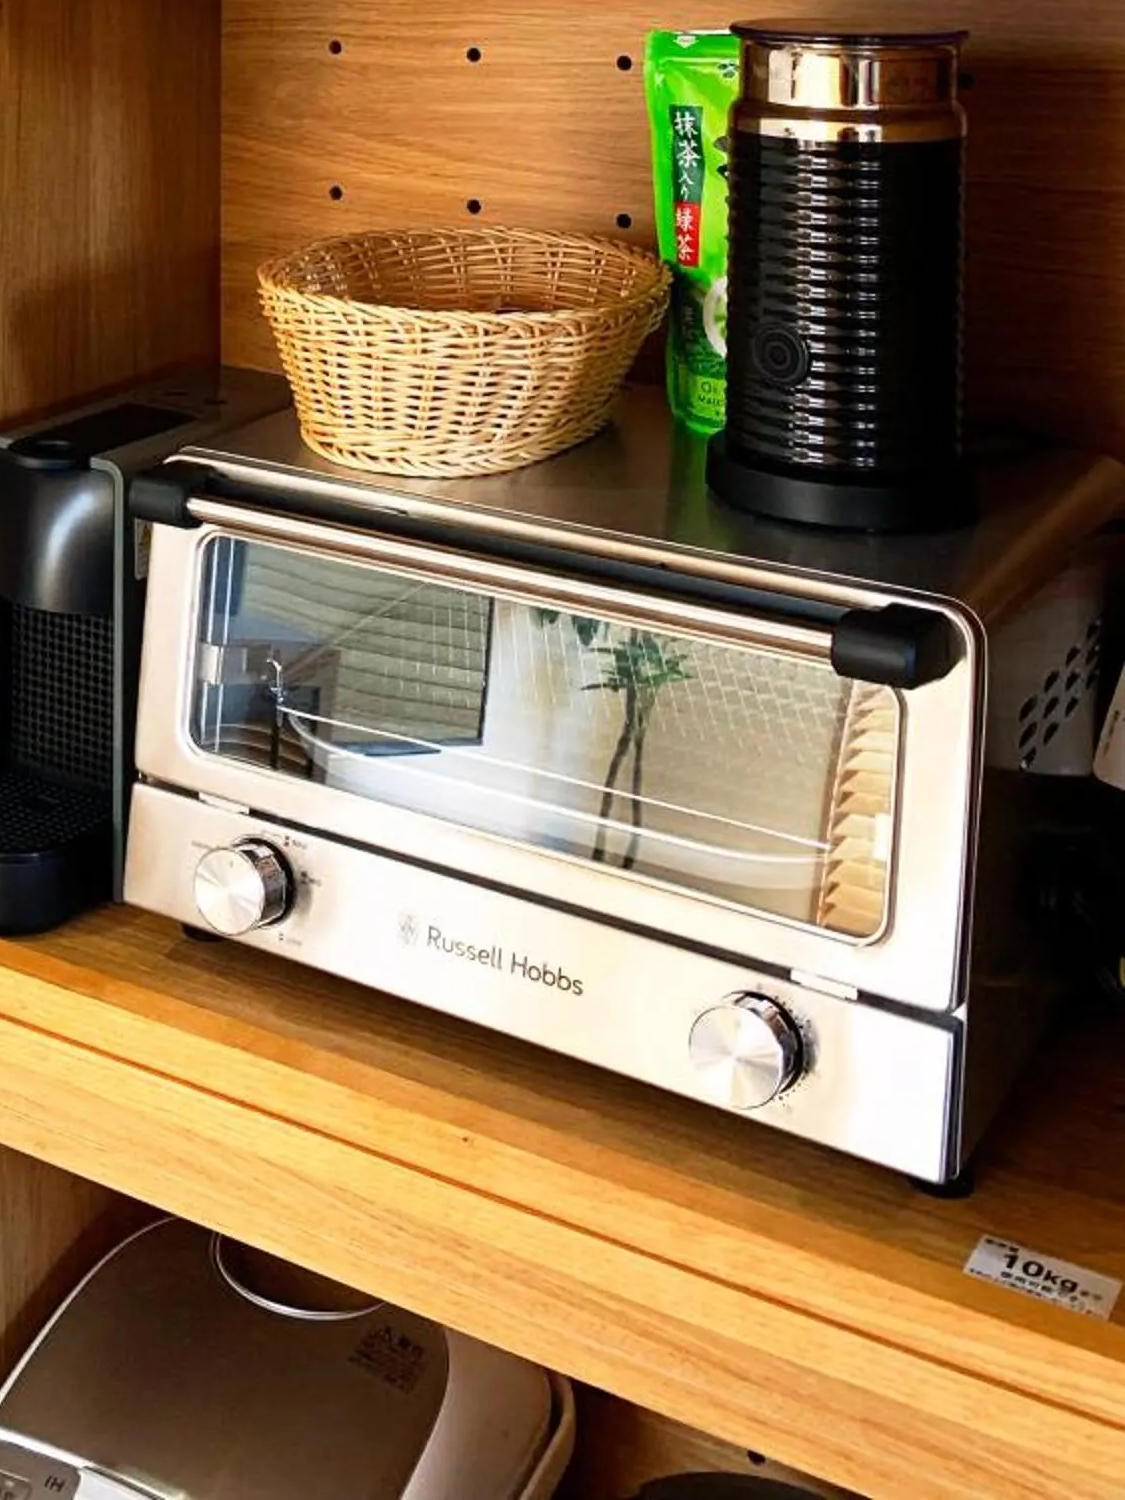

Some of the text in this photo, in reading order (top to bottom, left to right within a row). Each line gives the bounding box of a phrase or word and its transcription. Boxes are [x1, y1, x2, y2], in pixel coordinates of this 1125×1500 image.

[427, 925, 584, 996] Russell Hobbs
[1004, 1253, 1078, 1294] 10kg
